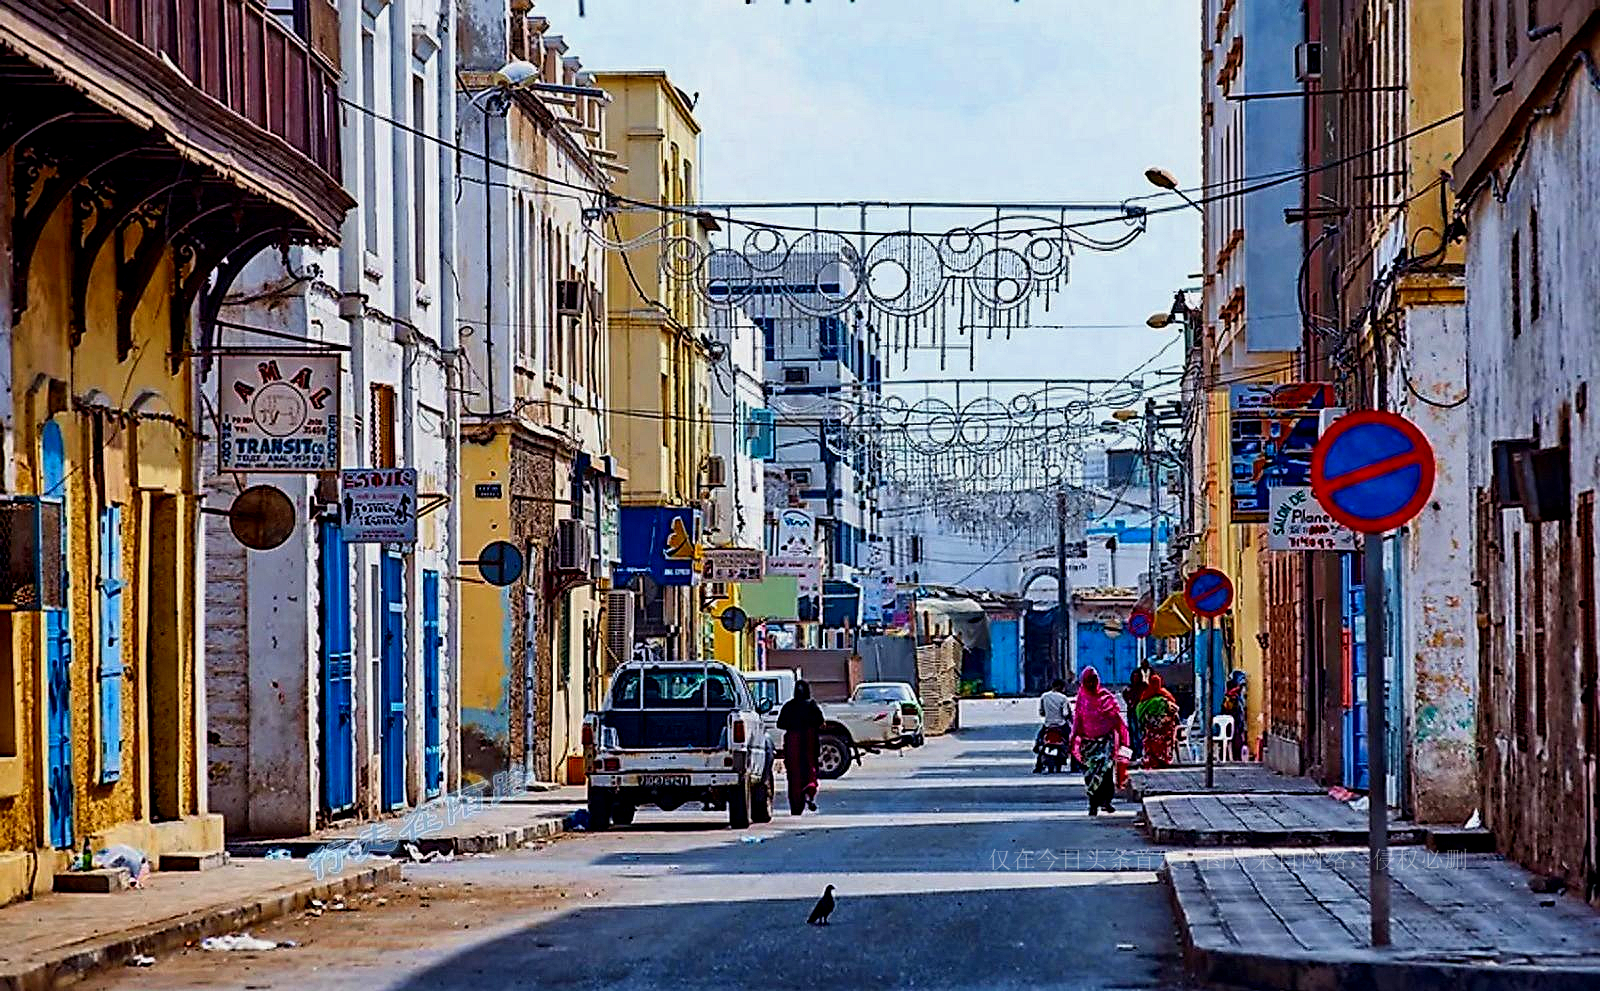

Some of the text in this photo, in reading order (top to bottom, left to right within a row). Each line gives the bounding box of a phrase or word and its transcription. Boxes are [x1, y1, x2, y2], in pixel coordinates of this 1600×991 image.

[233, 360, 332, 410] AMAL
[235, 438, 313, 454] TRANSIT
[1272, 490, 1307, 536] SALON DE
